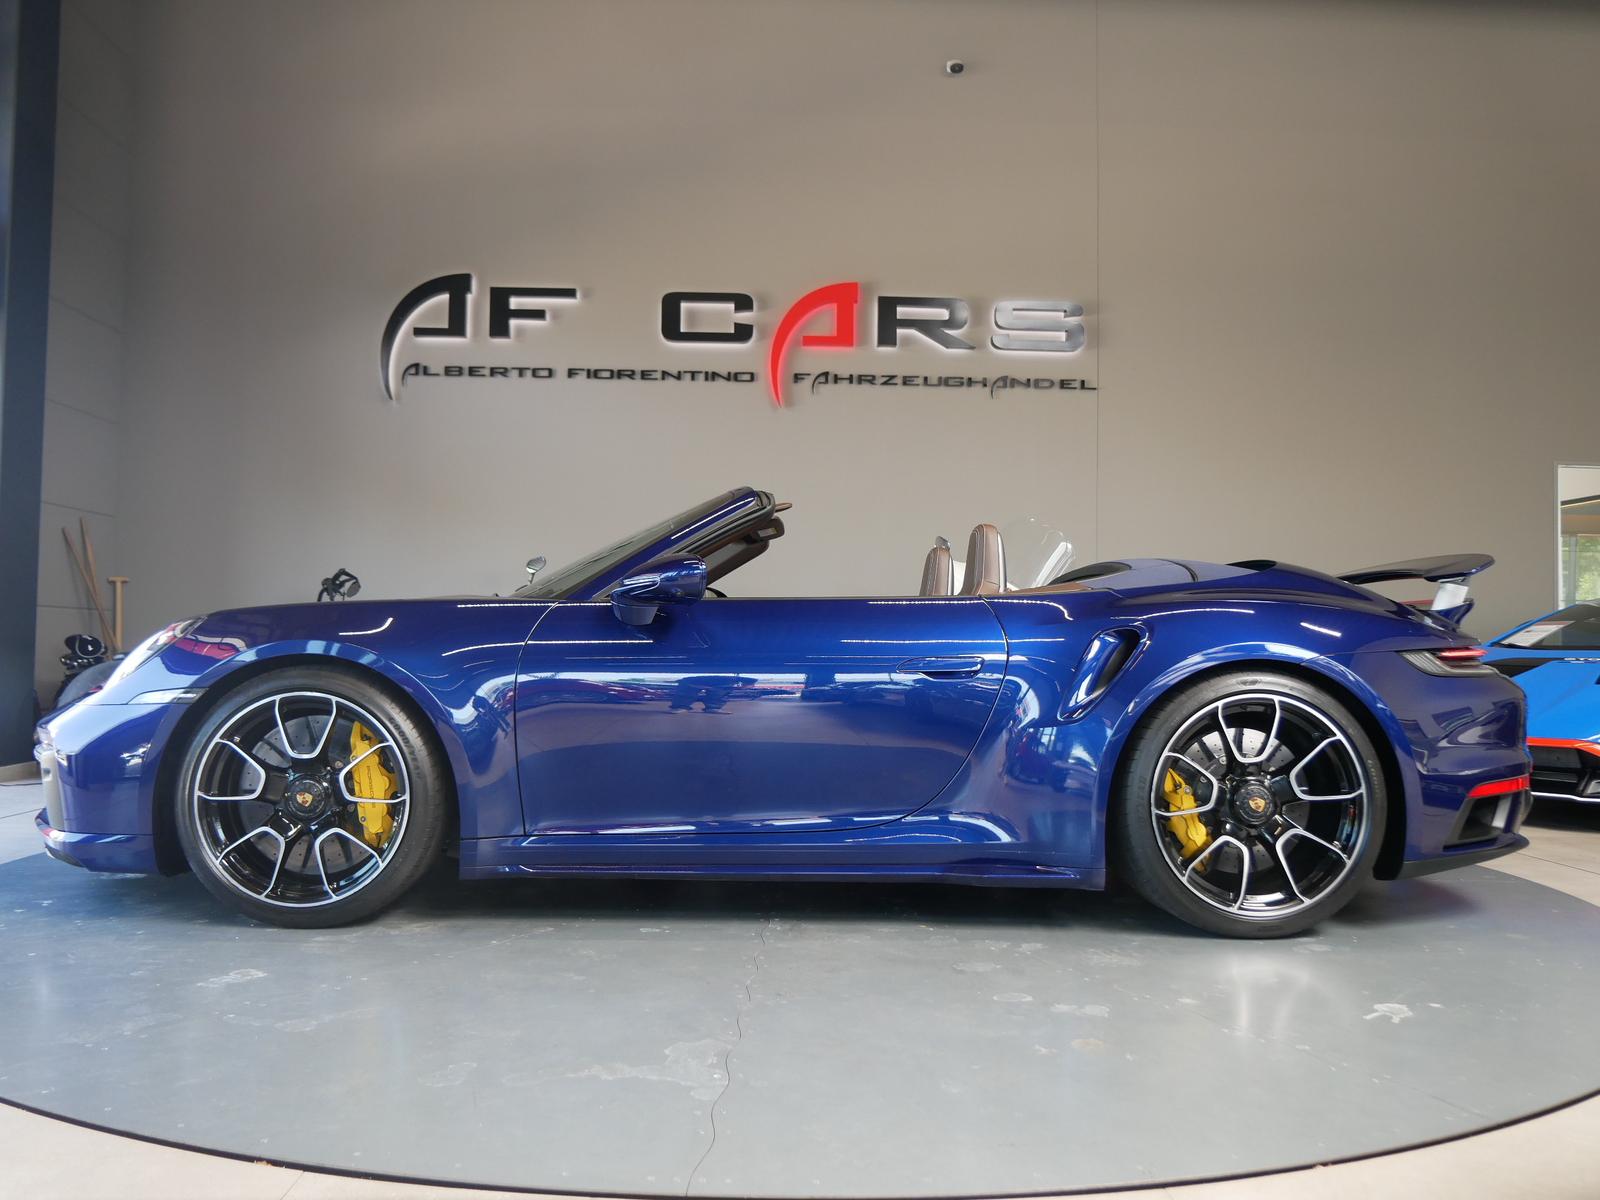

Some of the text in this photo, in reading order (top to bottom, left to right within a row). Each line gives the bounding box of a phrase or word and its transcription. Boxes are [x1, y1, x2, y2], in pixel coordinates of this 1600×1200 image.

[380, 273, 1085, 408] AF CARS
[402, 362, 1097, 399] ALBERTO FIORENTINO FAHRZEUGHANDEL
